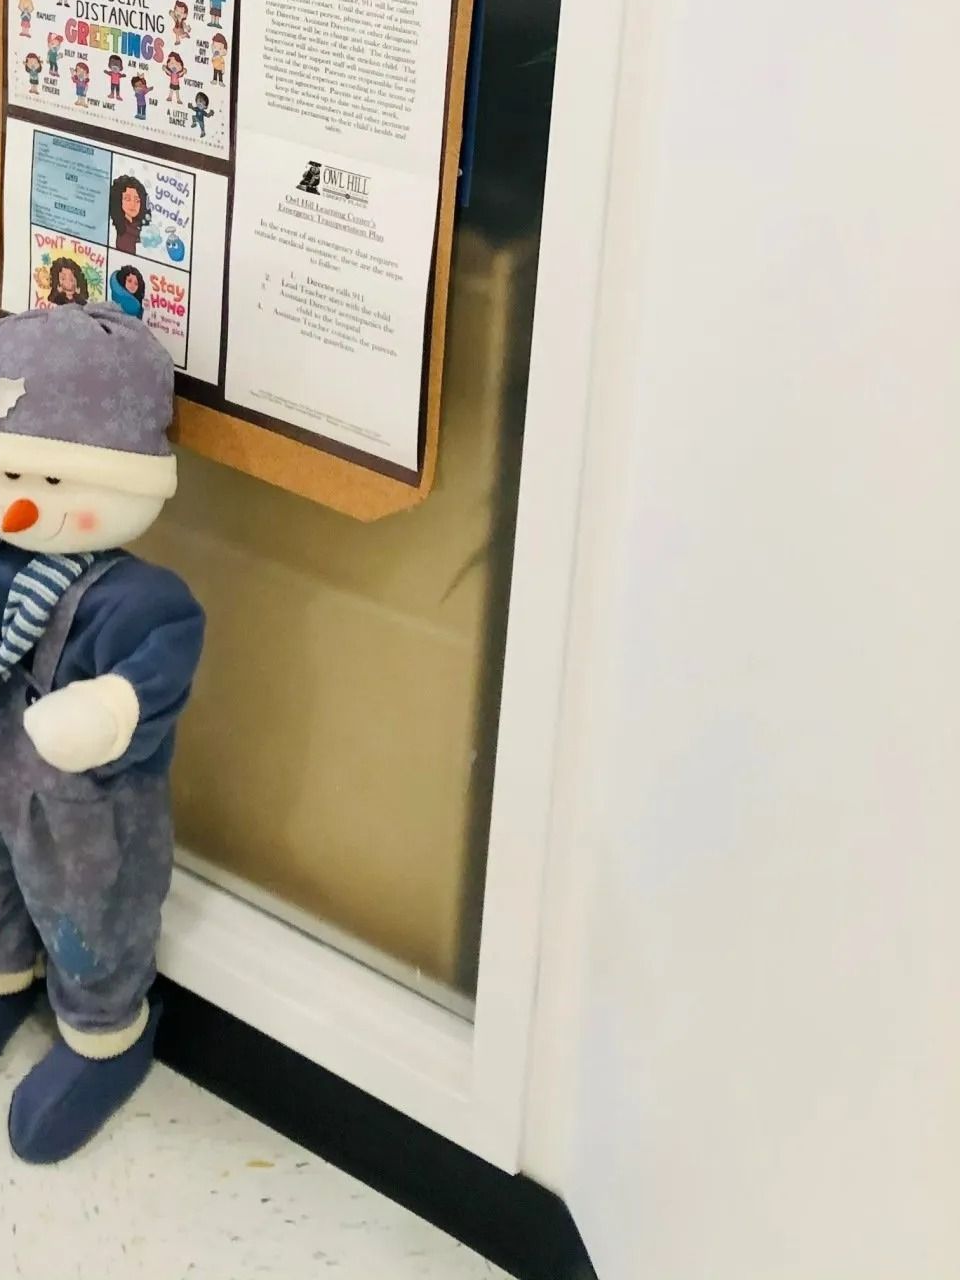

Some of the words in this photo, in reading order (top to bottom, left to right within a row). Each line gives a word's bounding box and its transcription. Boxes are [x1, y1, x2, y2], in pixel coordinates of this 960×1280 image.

[76, 0, 165, 34] DISTANCING
[193, 4, 206, 14] HIGH
[193, 12, 204, 22] FIVE
[64, 18, 165, 63] GREETINGS
[128, 60, 136, 68] AIR
[139, 62, 149, 71] HUG
[194, 55, 209, 65] HEART
[43, 77, 58, 86] HEART
[184, 78, 203, 89] VICTORY
[172, 110, 189, 120] LITTLE
[156, 172, 190, 198] wash
[323, 168, 344, 188] OWL
[347, 174, 368, 196] HILL
[155, 185, 185, 206] your
[146, 196, 190, 228] hands!
[70, 240, 105, 267] TOUCH
[150, 274, 185, 302] Stay
